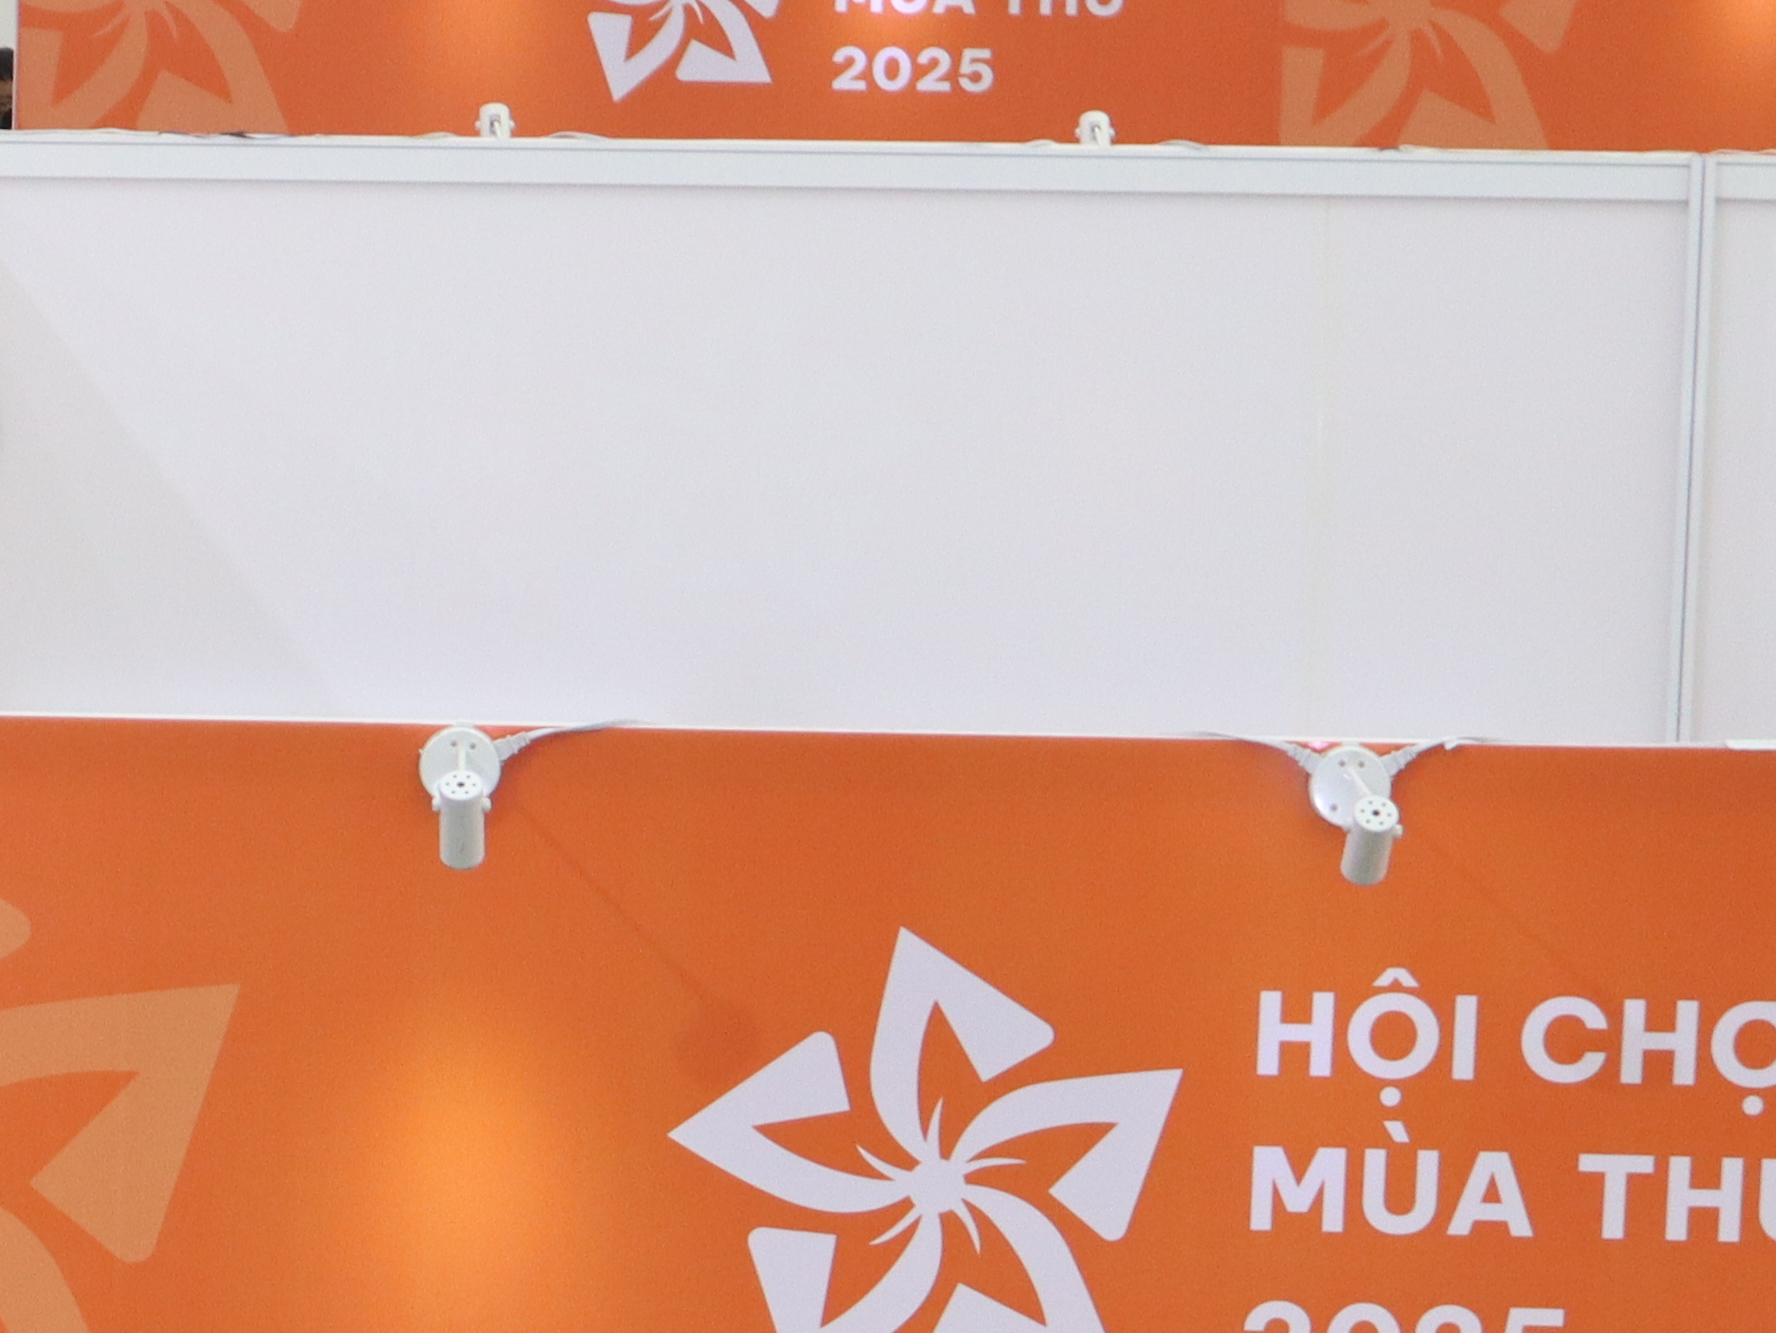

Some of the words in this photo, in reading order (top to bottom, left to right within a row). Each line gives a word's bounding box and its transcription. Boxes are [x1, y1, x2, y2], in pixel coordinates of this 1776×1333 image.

[831, 46, 995, 93] 2025
[1255, 967, 1478, 1108] HỘI
[1249, 1120, 1533, 1239] MÙA
[1578, 1153, 1776, 1243] TH
